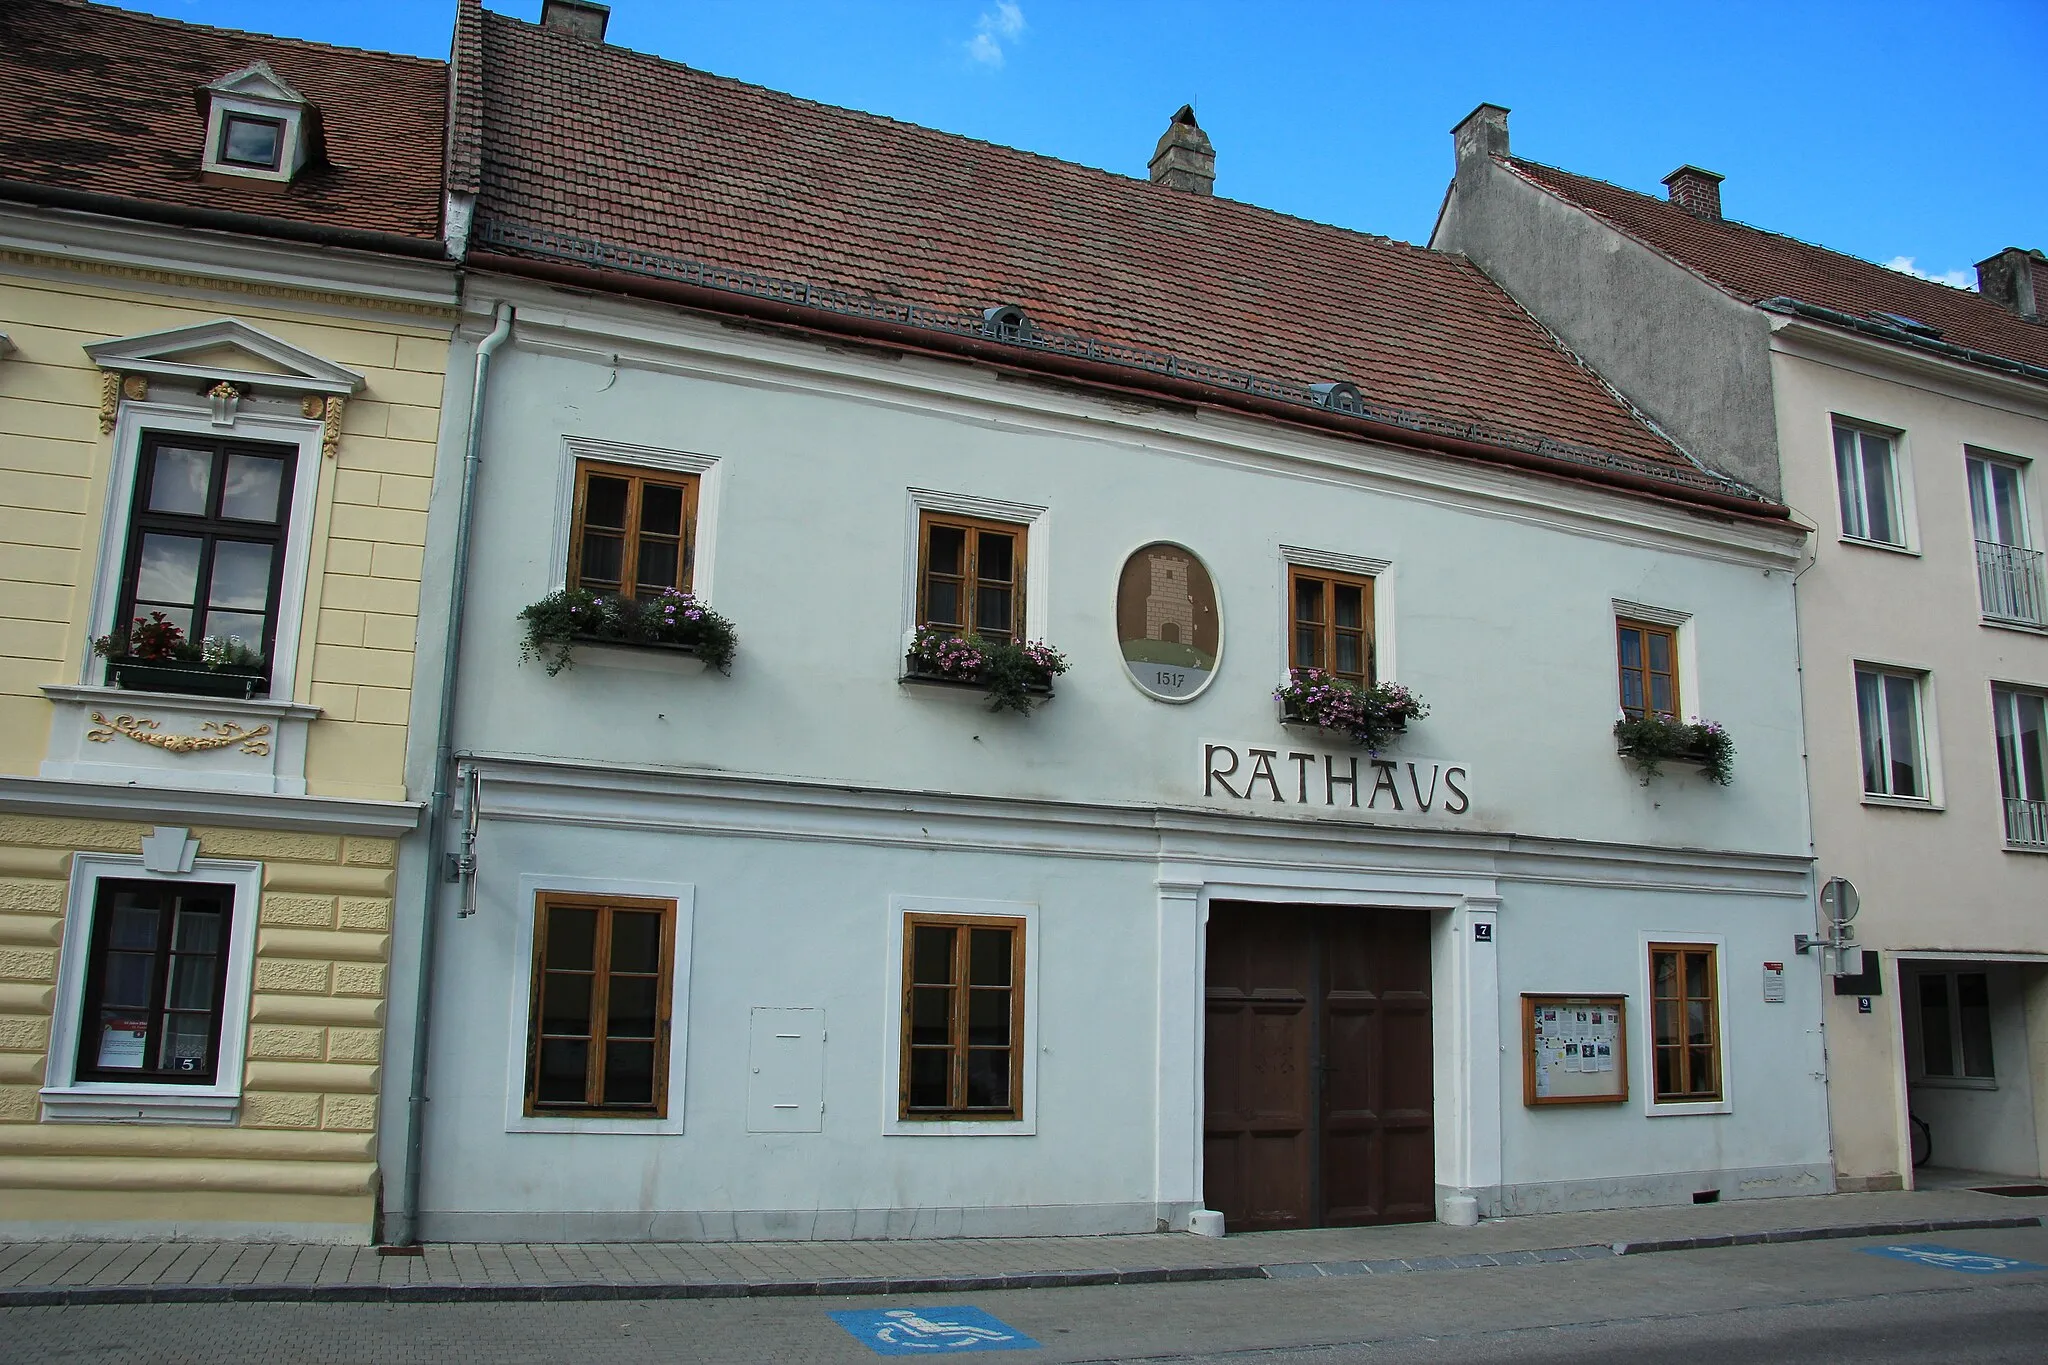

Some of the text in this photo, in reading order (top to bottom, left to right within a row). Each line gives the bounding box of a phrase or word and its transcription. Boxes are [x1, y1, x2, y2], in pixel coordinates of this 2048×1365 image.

[1156, 671, 1185, 688] 1517
[1480, 925, 1487, 935] 7
[1862, 998, 1868, 1007] 9
[181, 1058, 194, 1071] 5
